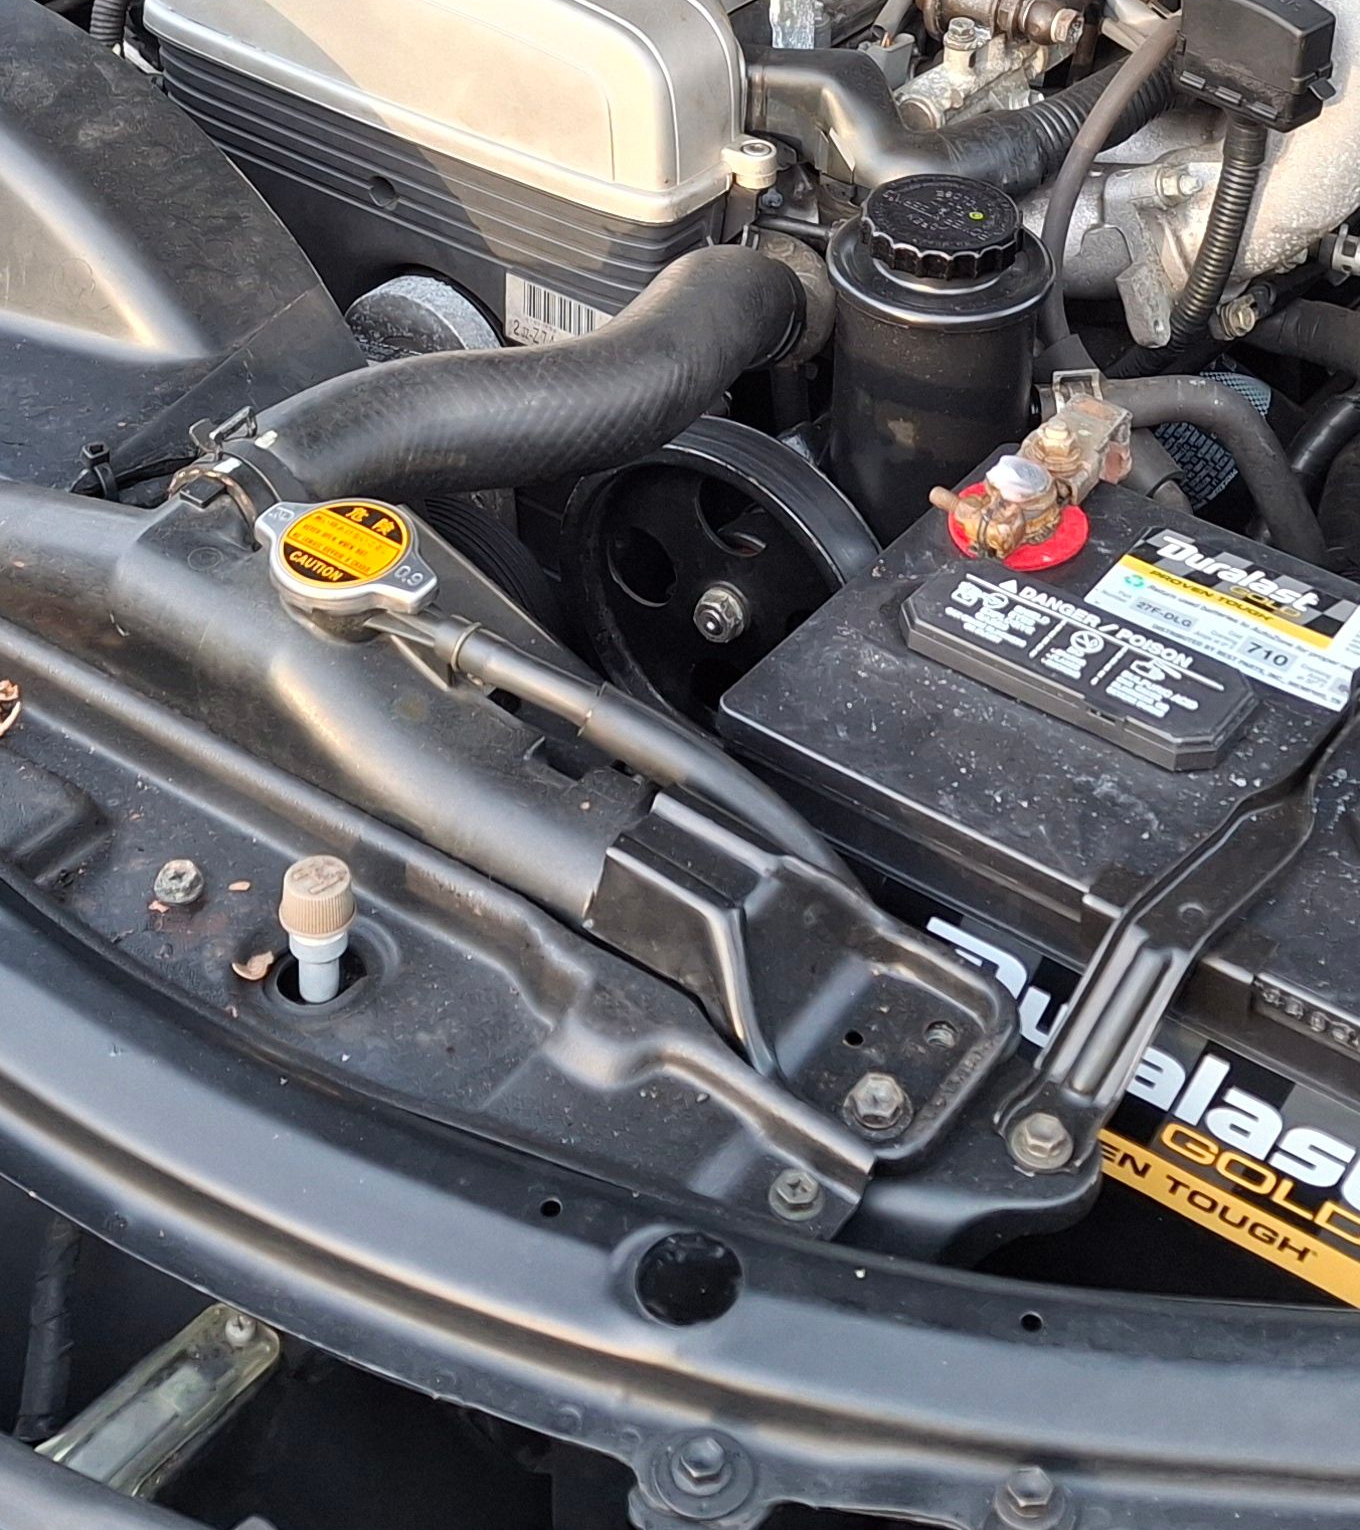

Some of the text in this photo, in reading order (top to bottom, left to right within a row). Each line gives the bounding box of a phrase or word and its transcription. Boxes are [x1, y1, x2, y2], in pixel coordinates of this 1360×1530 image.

[290, 551, 423, 586] CAUTION 0.9
[1156, 535, 1320, 612] Duralast
[1149, 570, 1274, 621] PROVEN TOUGH
[1230, 585, 1301, 619] GOLD
[1136, 601, 1192, 628] 27F-DLG
[1247, 642, 1288, 666] 710
[1166, 1175, 1314, 1264] TOUGH
